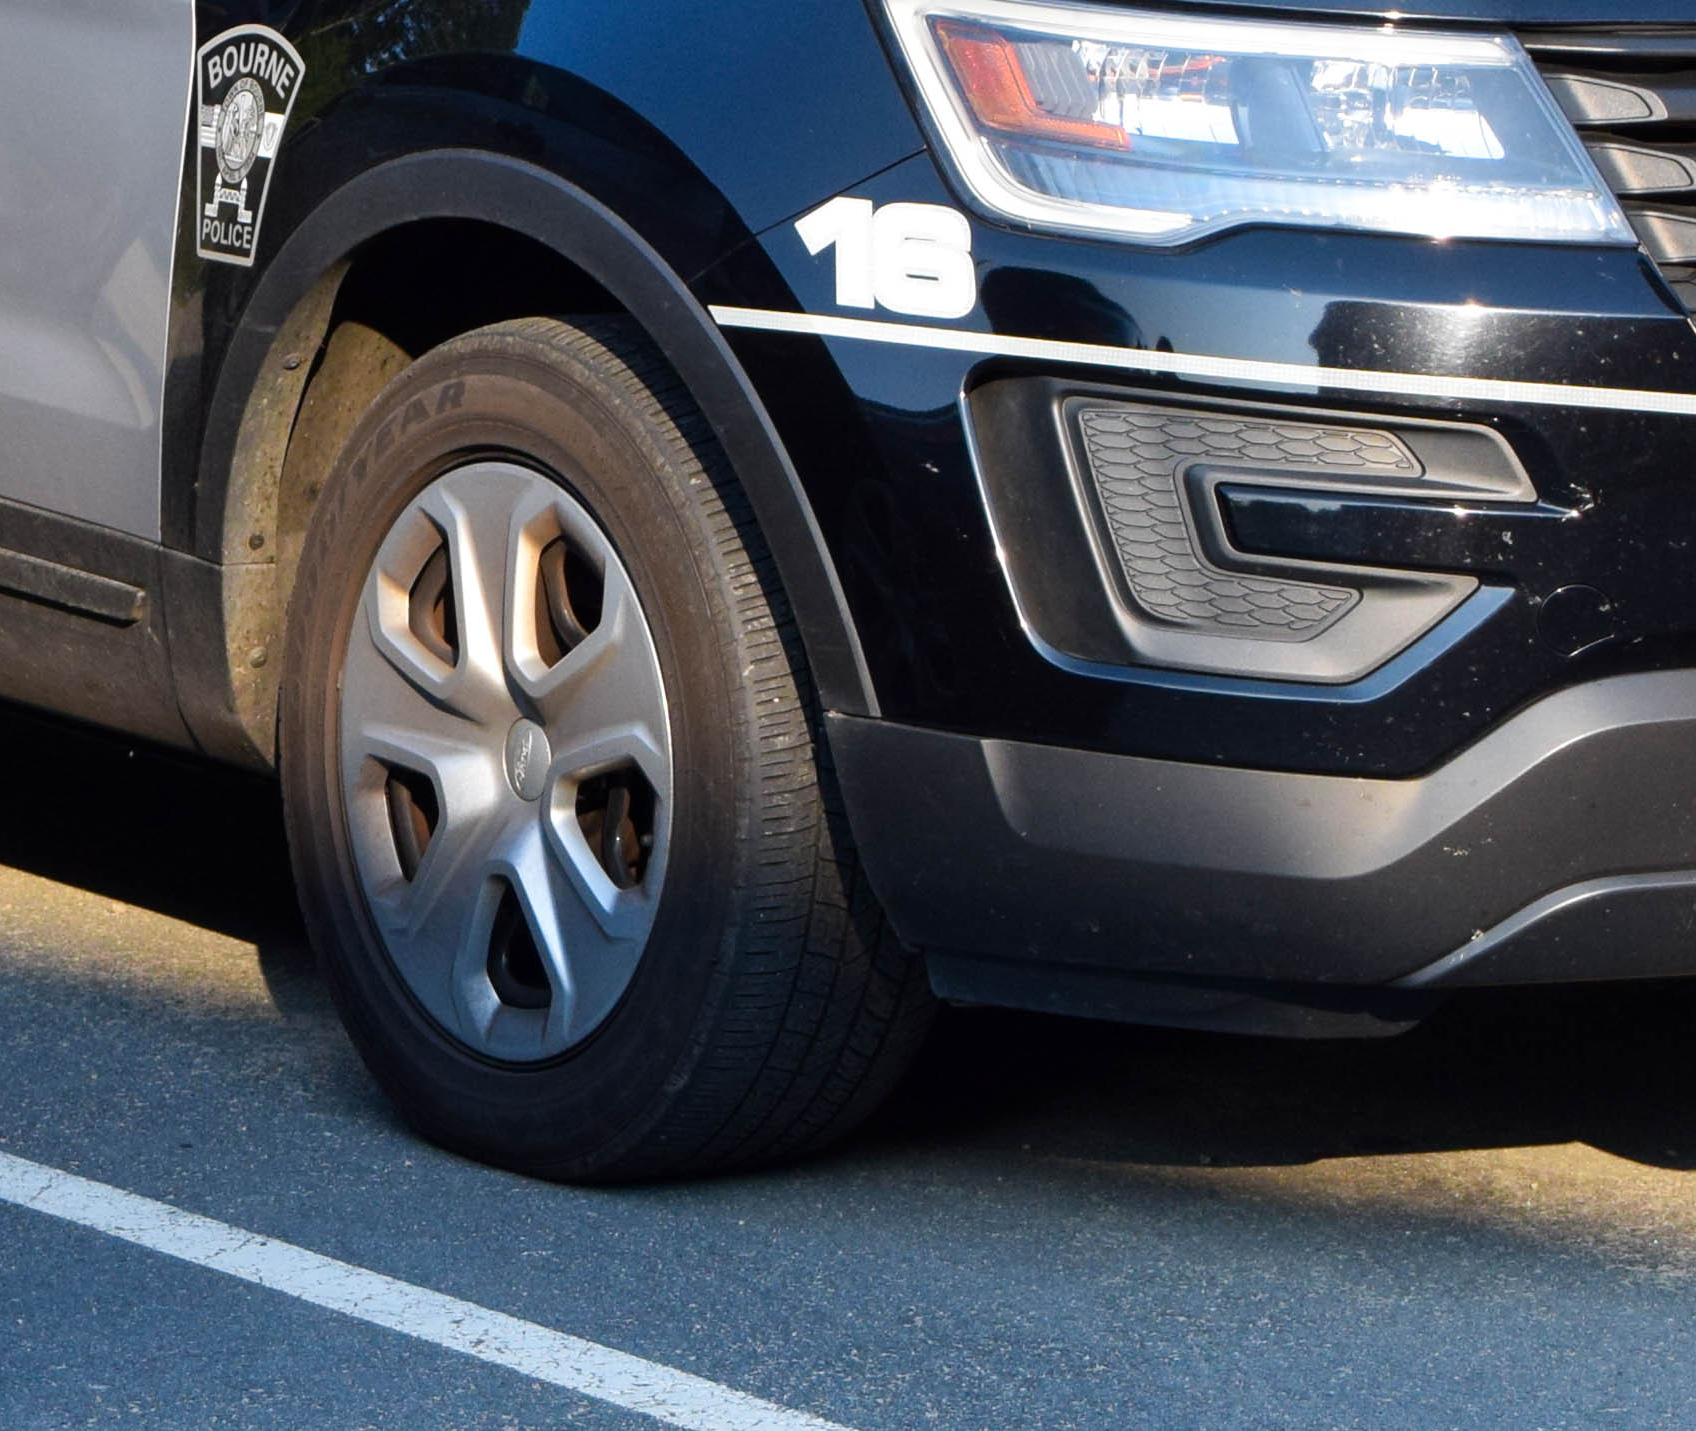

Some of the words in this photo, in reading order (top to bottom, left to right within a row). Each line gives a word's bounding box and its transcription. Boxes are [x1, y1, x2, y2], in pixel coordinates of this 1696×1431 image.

[207, 41, 295, 100] BOURNE
[202, 219, 253, 249] POLICE
[794, 196, 977, 319] 16
